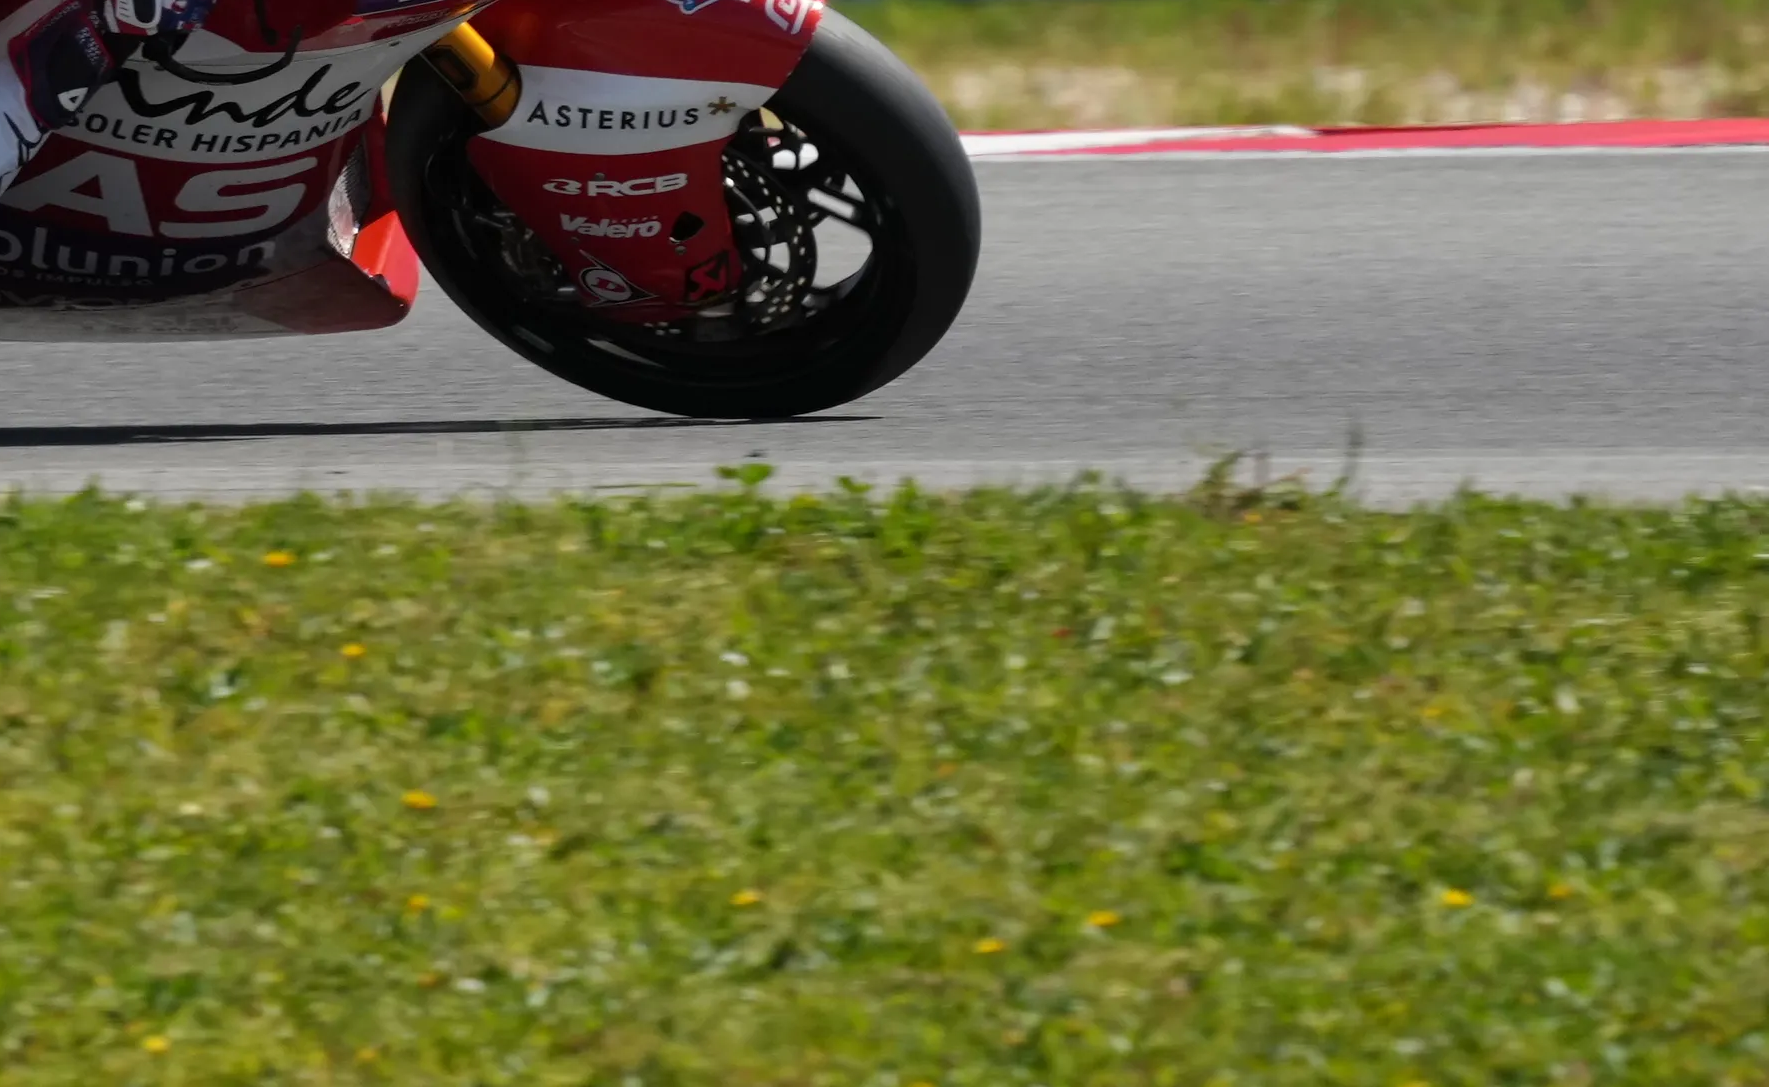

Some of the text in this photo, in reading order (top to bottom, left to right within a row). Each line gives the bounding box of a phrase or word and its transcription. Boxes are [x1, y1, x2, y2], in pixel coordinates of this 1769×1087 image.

[527, 100, 699, 130] ASTERIUS
[191, 108, 363, 154] HISPANIA
[587, 172, 689, 197] RCB
[559, 212, 662, 239] Valero
